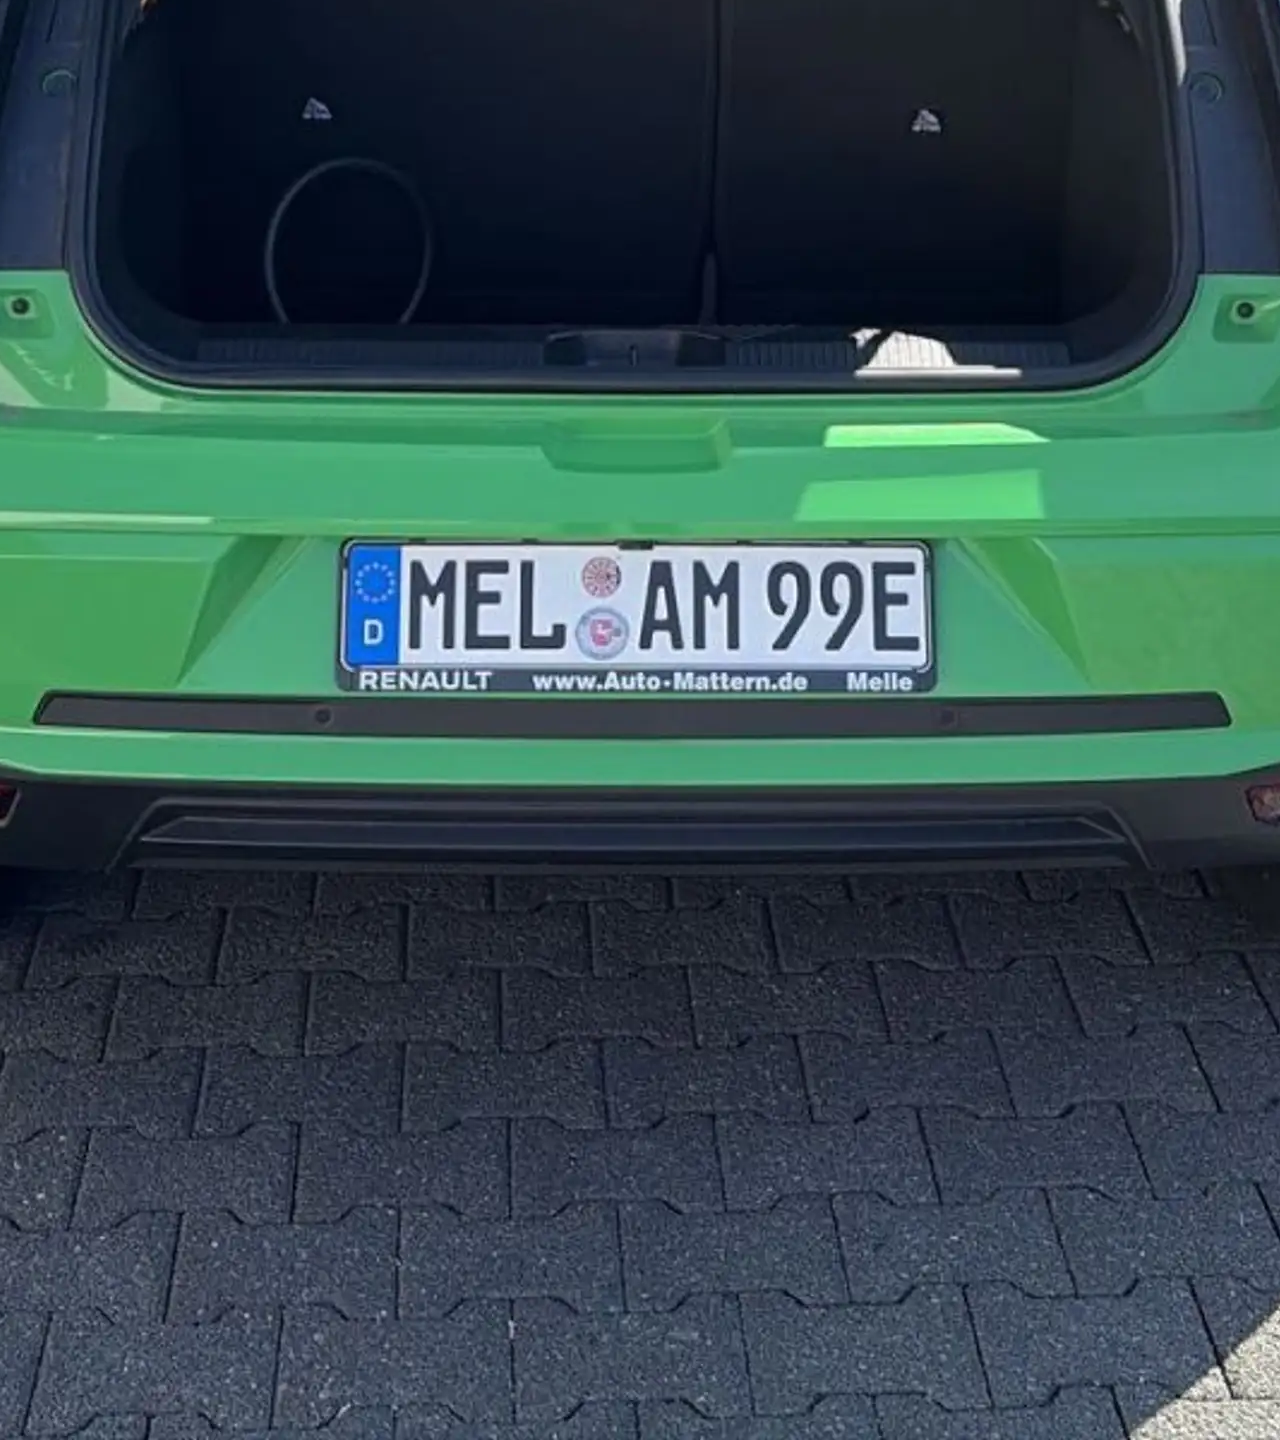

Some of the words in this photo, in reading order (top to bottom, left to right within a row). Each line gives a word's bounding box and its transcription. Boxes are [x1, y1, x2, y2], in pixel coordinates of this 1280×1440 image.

[408, 559, 567, 651] MEL
[638, 559, 741, 651] AM
[766, 560, 921, 652] 99E
[363, 618, 385, 646] D
[358, 670, 493, 691] RENAULT
[846, 671, 914, 692] Melle
